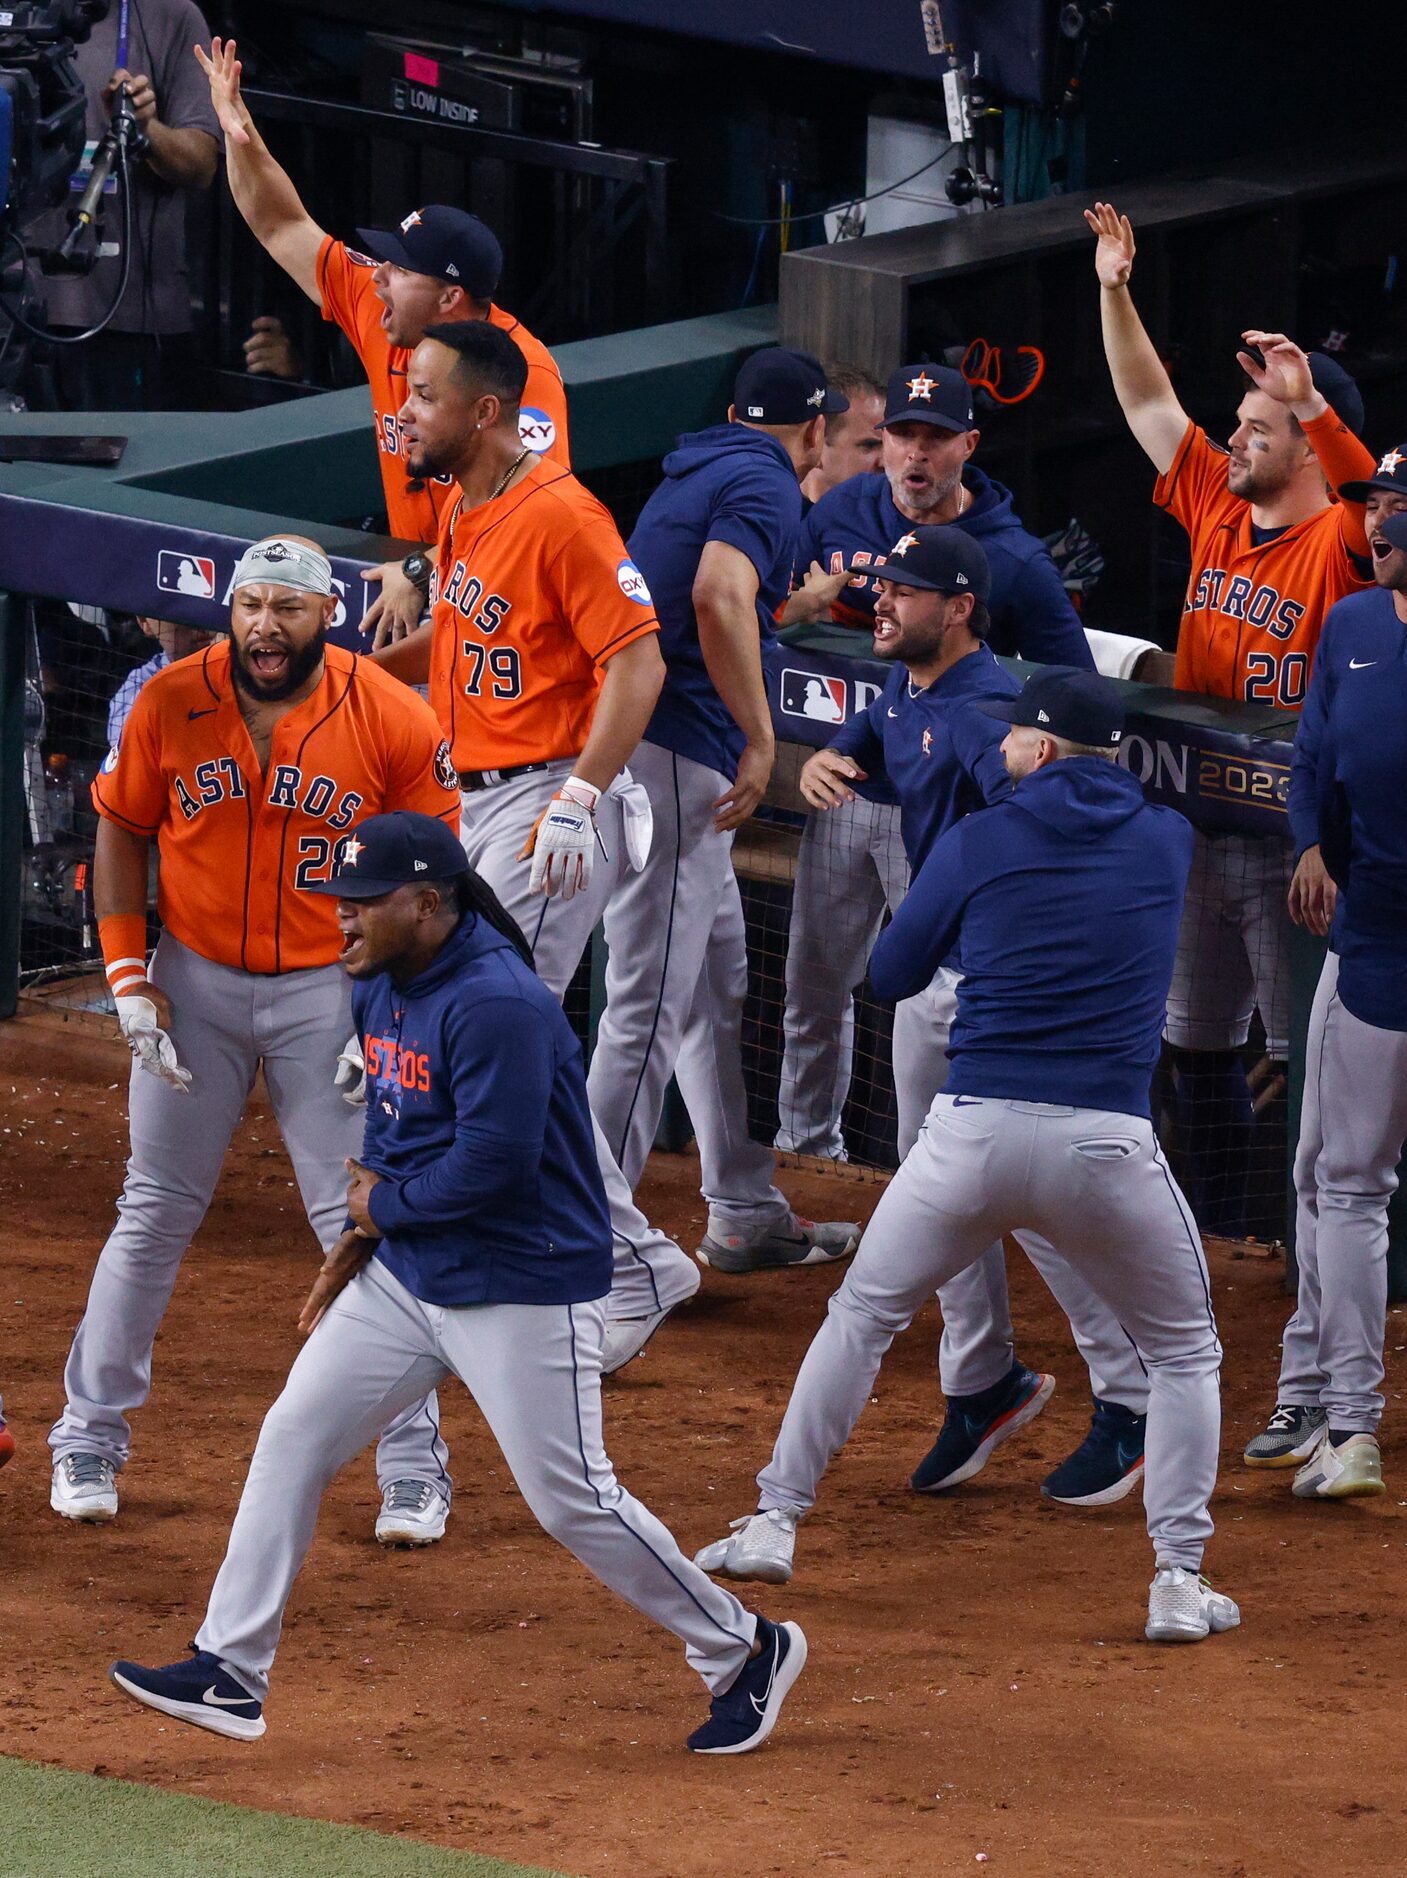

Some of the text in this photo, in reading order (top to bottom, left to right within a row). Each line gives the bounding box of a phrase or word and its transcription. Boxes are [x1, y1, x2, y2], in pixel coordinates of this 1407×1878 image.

[411, 89, 437, 113] LOW
[439, 97, 479, 122] INSIDE
[518, 424, 553, 439] XY
[252, 548, 302, 564] POSTSEASON
[428, 560, 511, 634] TROS
[620, 575, 646, 593] OXY
[463, 641, 522, 700] 79
[1244, 652, 1308, 706] 20
[175, 757, 363, 829] ASTROS
